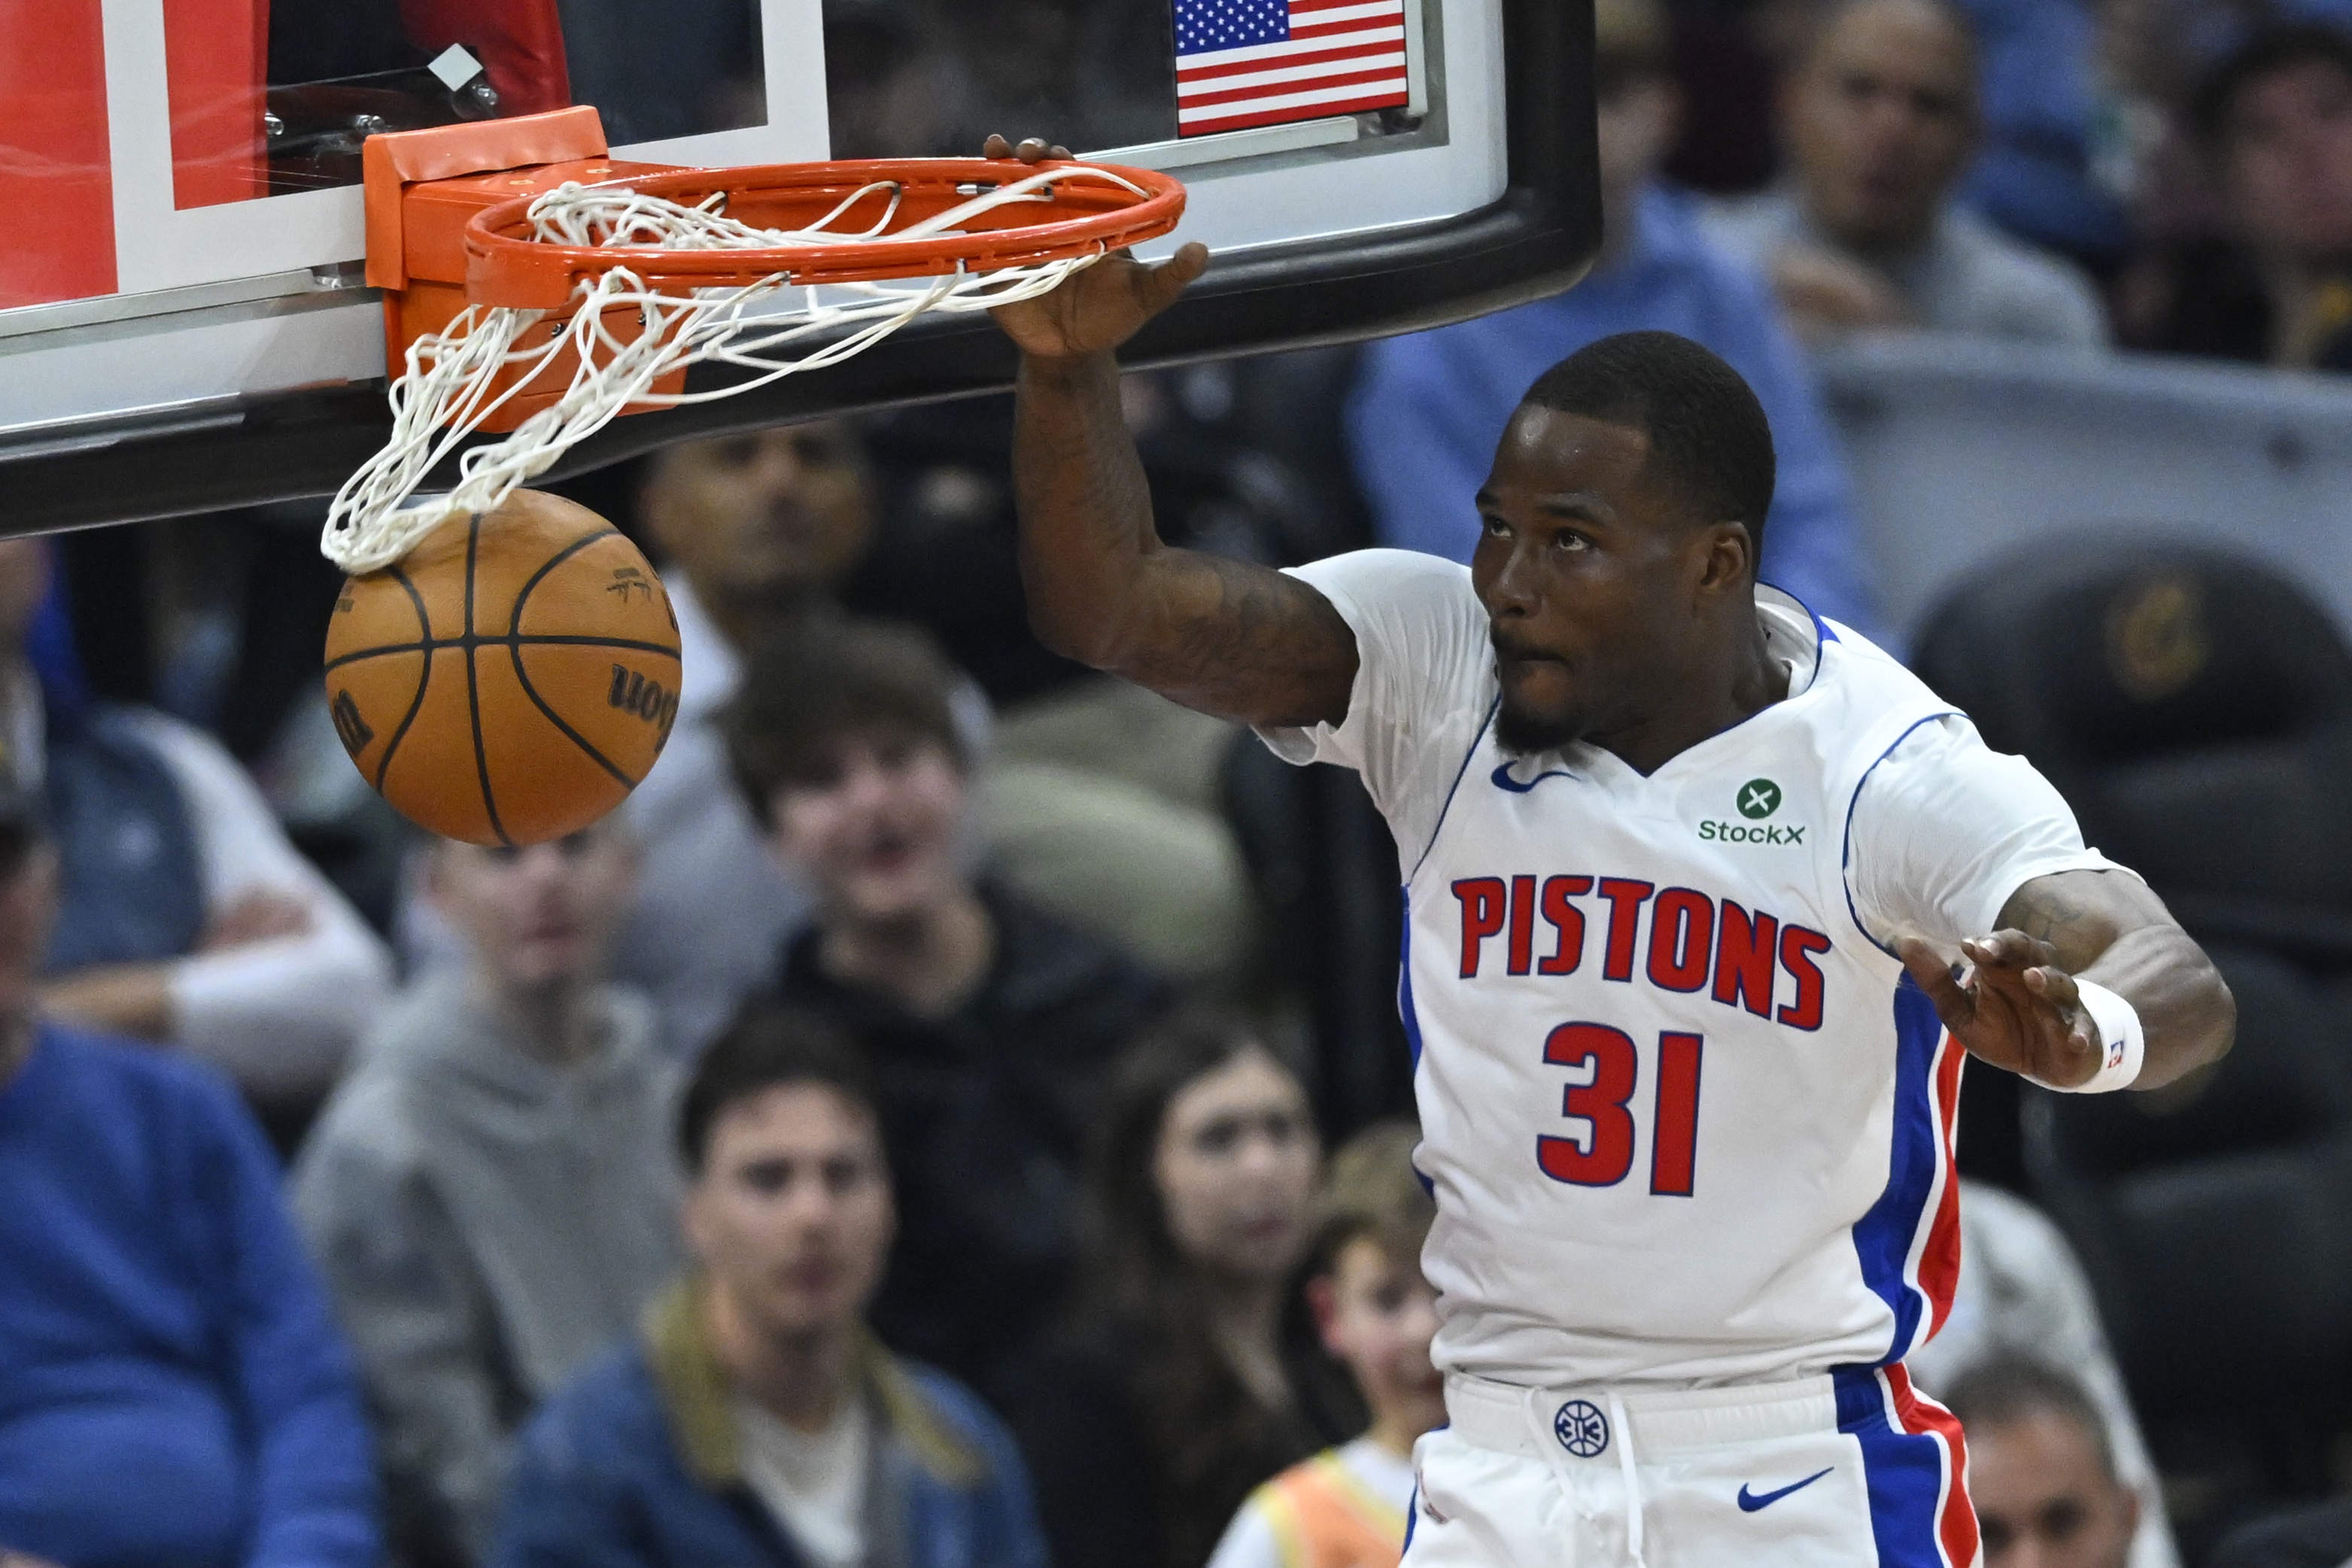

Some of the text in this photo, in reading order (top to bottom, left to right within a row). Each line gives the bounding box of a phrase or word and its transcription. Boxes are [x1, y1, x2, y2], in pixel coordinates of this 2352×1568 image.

[1697, 819, 1806, 846] StockX
[1451, 874, 1831, 1032] PISTONS
[1536, 1020, 1704, 1197] 31
